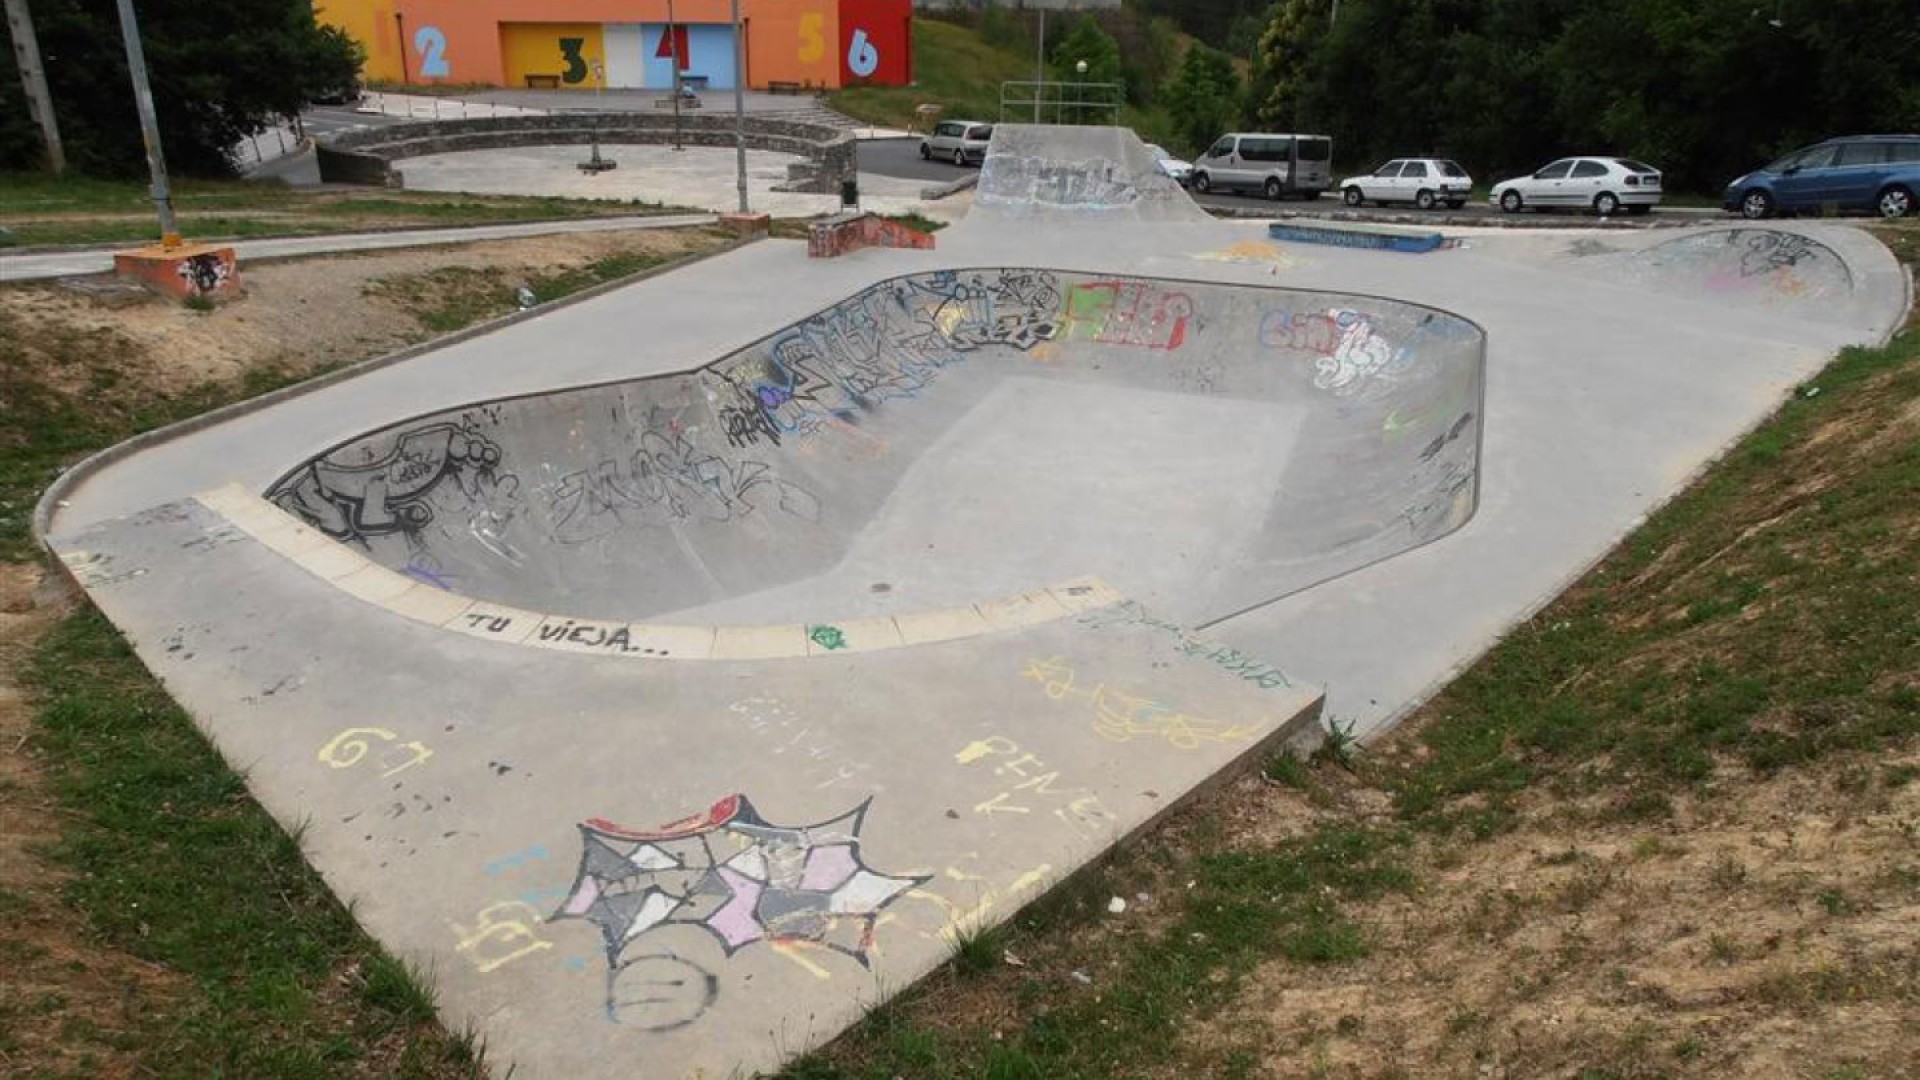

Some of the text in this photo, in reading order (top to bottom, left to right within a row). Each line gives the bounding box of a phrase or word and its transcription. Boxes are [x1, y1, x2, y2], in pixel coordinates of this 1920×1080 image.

[415, 27, 449, 76] 2
[559, 38, 587, 83] 3
[655, 24, 689, 70] 4
[799, 12, 823, 63] 5
[848, 28, 878, 76] 6
[466, 614, 511, 632] TU
